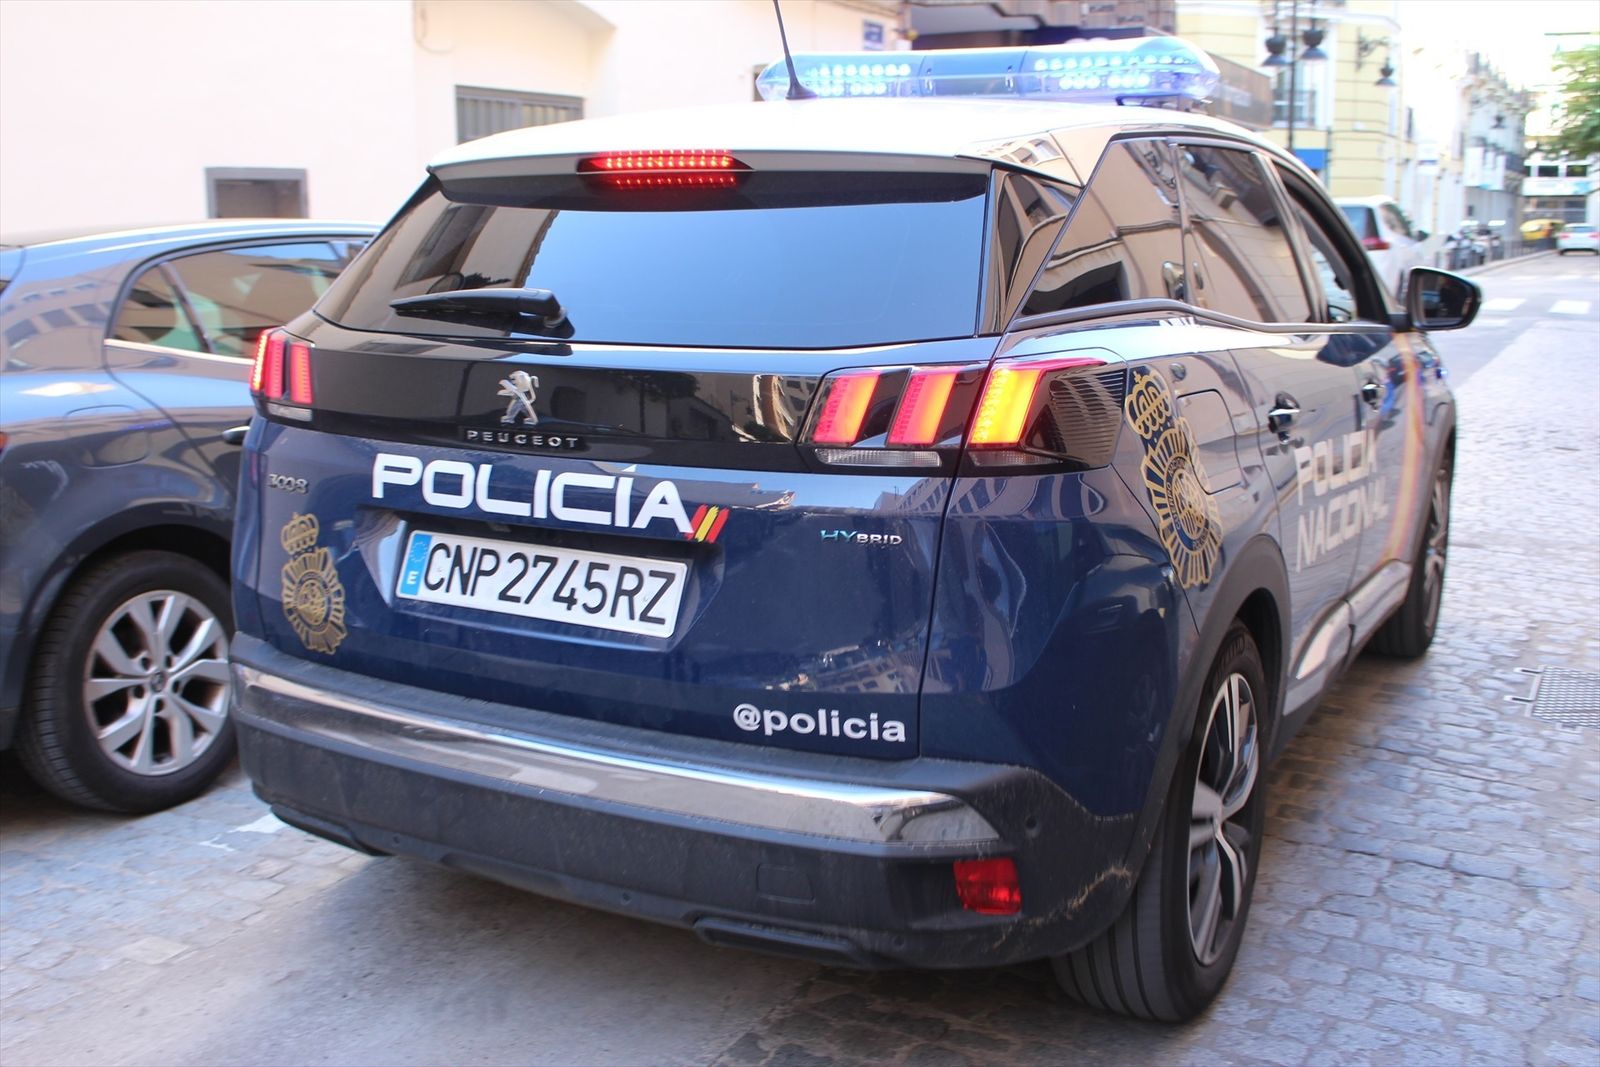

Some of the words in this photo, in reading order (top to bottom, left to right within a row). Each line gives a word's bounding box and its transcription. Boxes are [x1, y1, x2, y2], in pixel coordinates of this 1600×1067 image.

[466, 430, 578, 448] PEUGEOT
[269, 473, 308, 493] 3008
[372, 452, 694, 533] POLICÍA
[820, 529, 902, 545] HYBRID
[406, 571, 417, 585] E
[733, 703, 906, 742] @policia
